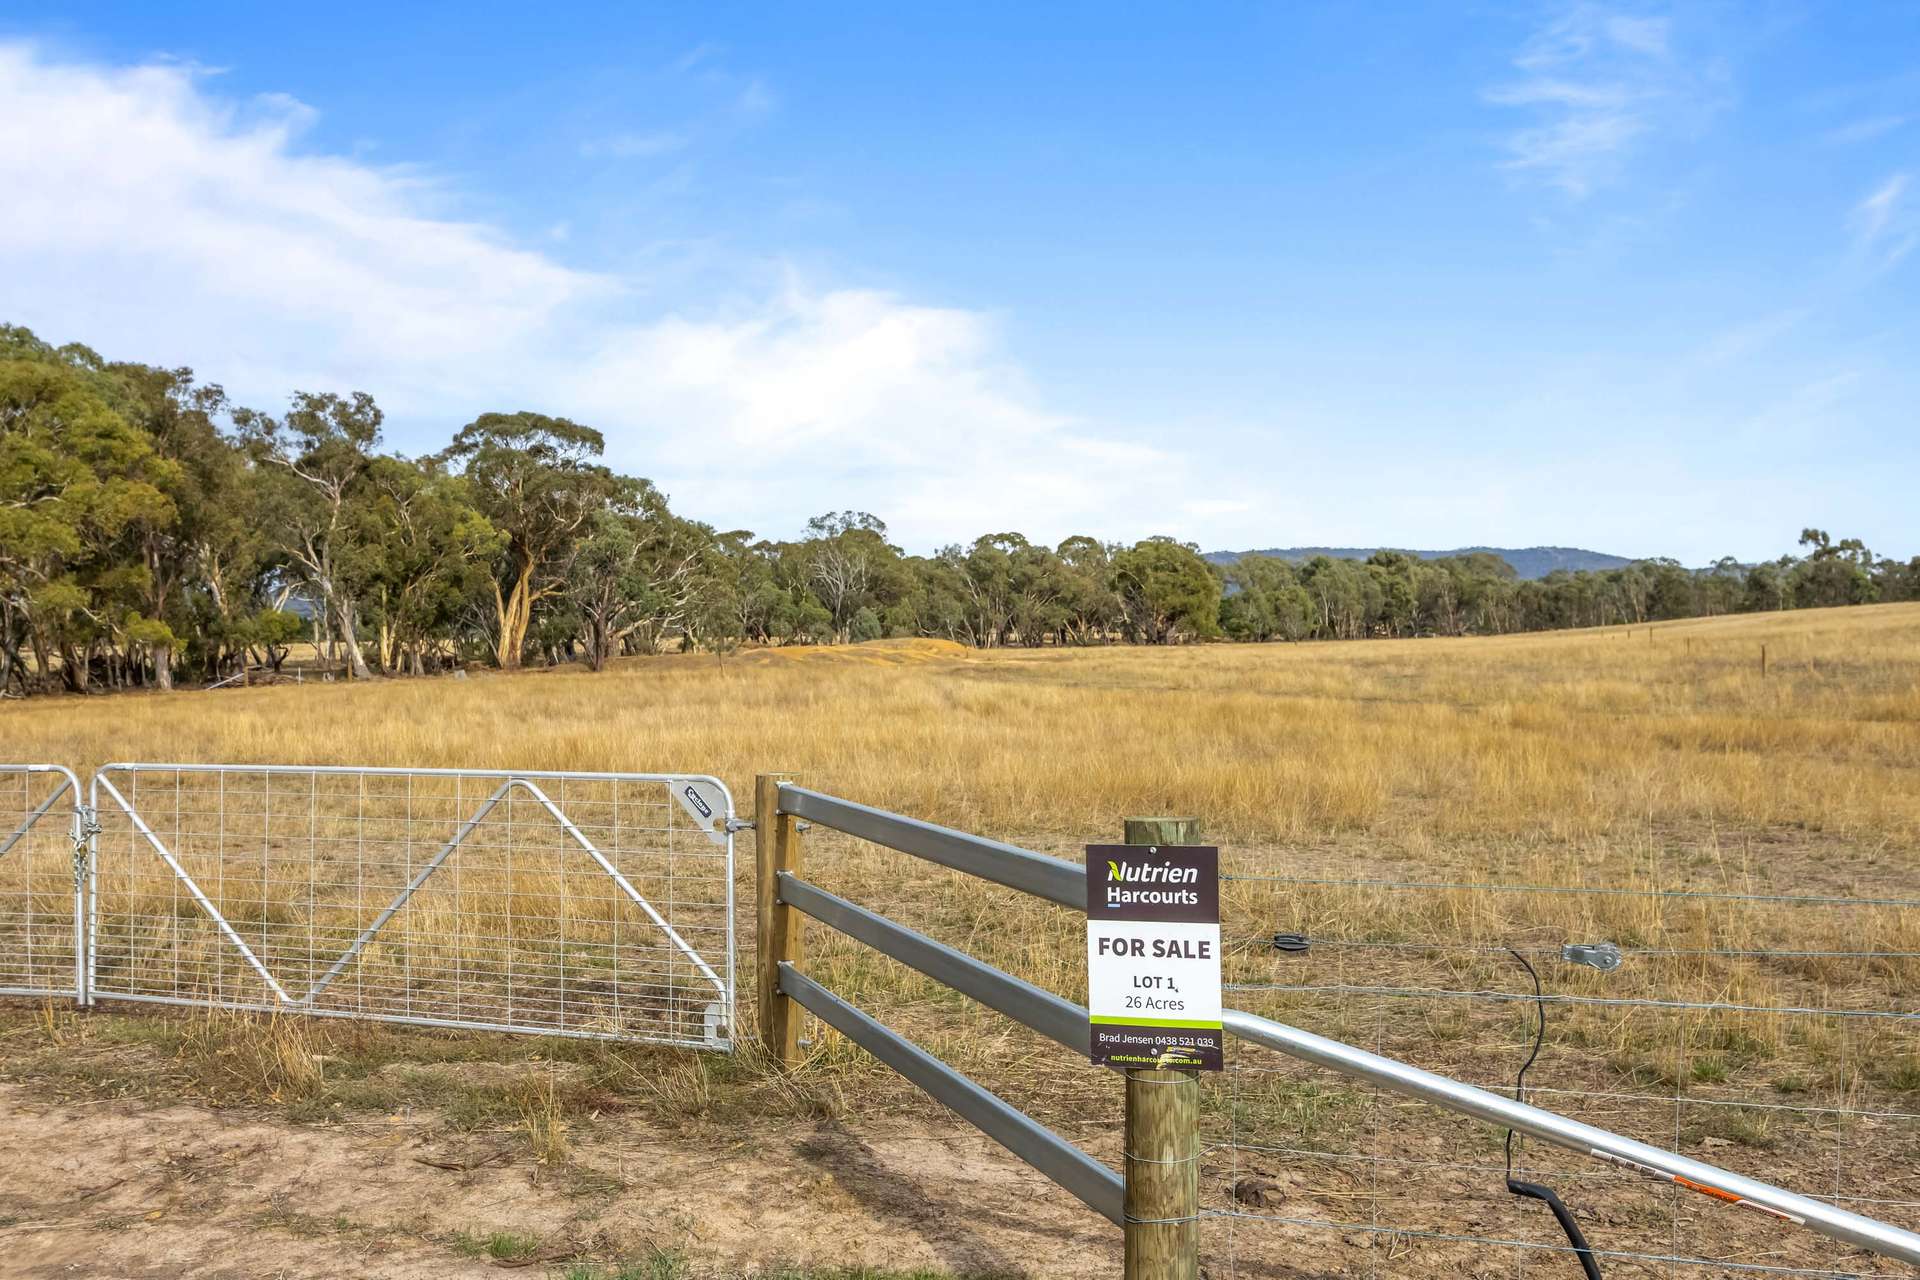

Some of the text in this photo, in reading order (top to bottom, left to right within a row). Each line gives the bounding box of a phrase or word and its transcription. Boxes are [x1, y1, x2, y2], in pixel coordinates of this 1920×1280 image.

[1107, 860, 1198, 884] Nutrien
[1107, 887, 1198, 905] Harcourts
[1098, 937, 1211, 960] FOR SALE
[1133, 975, 1163, 989] LOT
[1125, 995, 1185, 1011] 26 Acres
[1099, 1032, 1120, 1043] Brad
[1122, 1034, 1153, 1045] Jensen
[1155, 1036, 1177, 1046] 0438
[1197, 1037, 1214, 1047] 039
